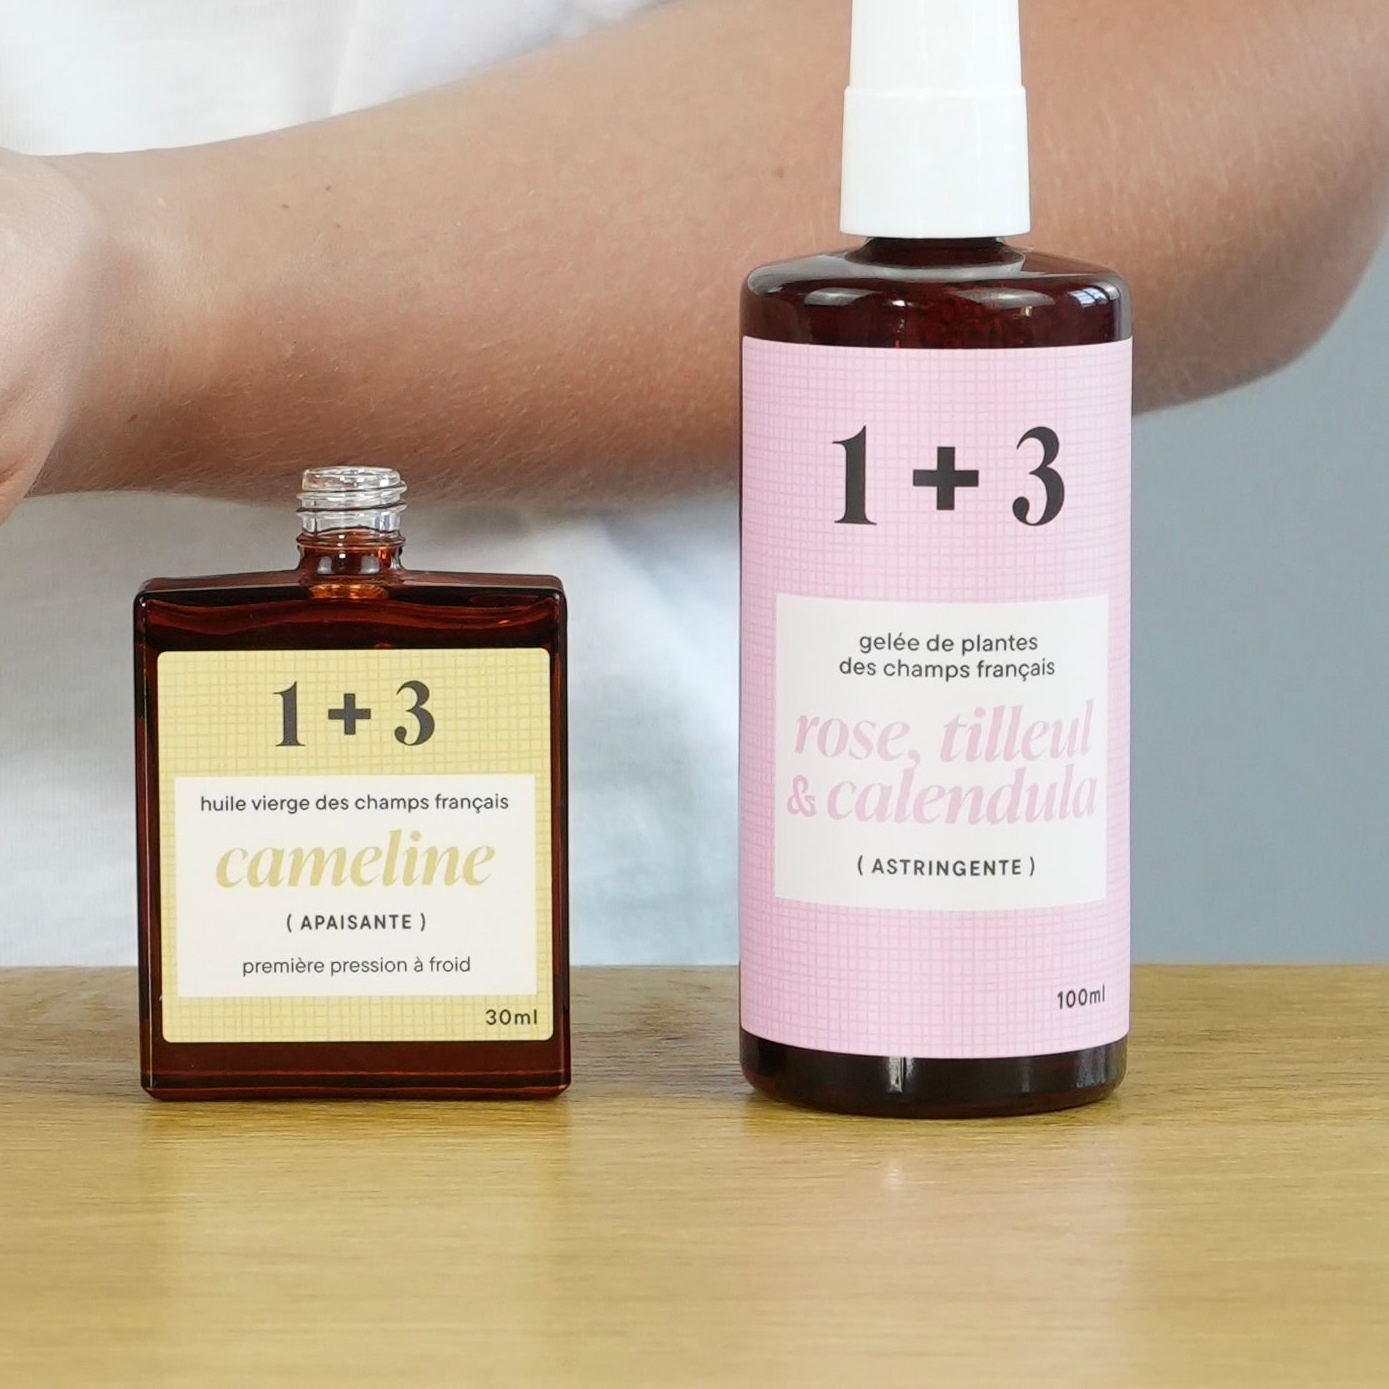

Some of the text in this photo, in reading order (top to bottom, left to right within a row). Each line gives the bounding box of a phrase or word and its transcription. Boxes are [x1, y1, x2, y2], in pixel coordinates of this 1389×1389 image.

[831, 425, 877, 526] 1
[1011, 425, 1065, 527] 3
[859, 632, 1038, 657] gelée de plantes
[839, 656, 1055, 683] des champs français
[272, 680, 306, 747] 1
[393, 679, 436, 747] 3
[795, 699, 1093, 771] rose, tilleul
[200, 793, 509, 815] huile vierge des champs français
[786, 764, 1097, 825] & calendula
[216, 829, 495, 889] cameline
[242, 955, 471, 978] première pression à froid
[1057, 984, 1105, 1010] 100ml
[485, 1008, 538, 1026] 30ml
